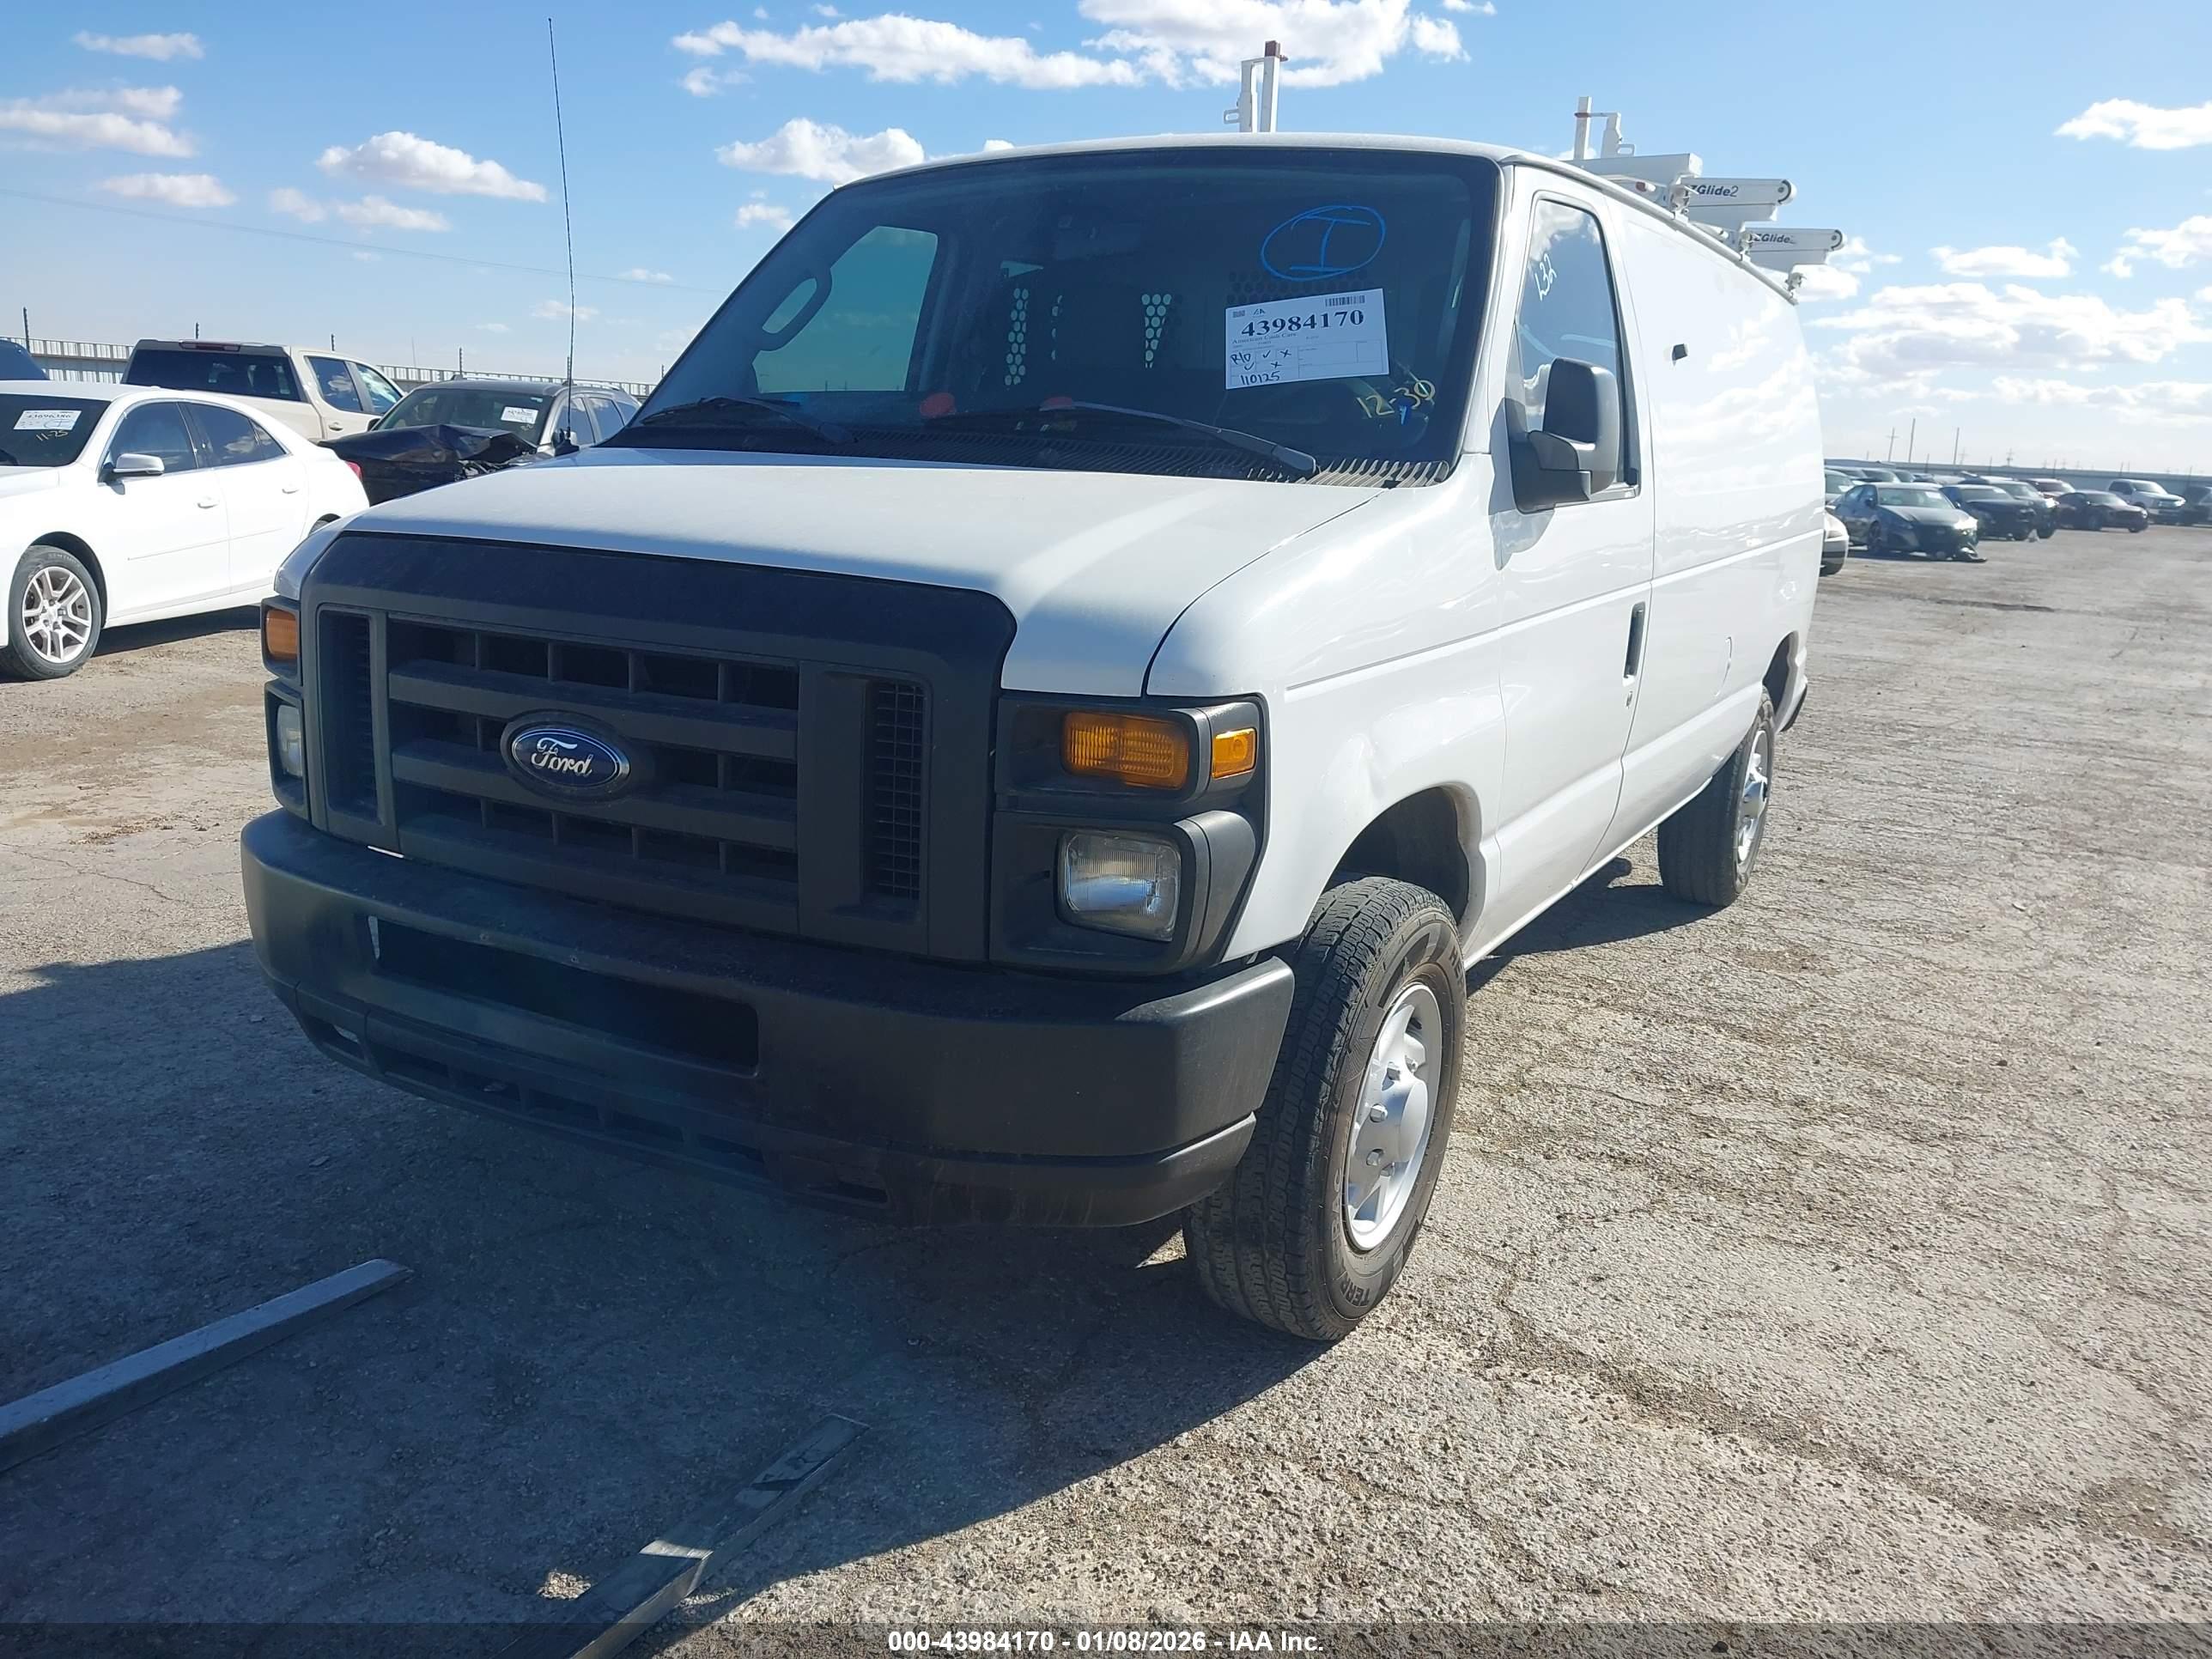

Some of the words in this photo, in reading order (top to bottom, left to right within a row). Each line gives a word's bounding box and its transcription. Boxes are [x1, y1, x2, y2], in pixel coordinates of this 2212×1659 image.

[1241, 309, 1364, 337] 43984170
[1240, 370, 1280, 386] 110125
[531, 737, 594, 777] Ford
